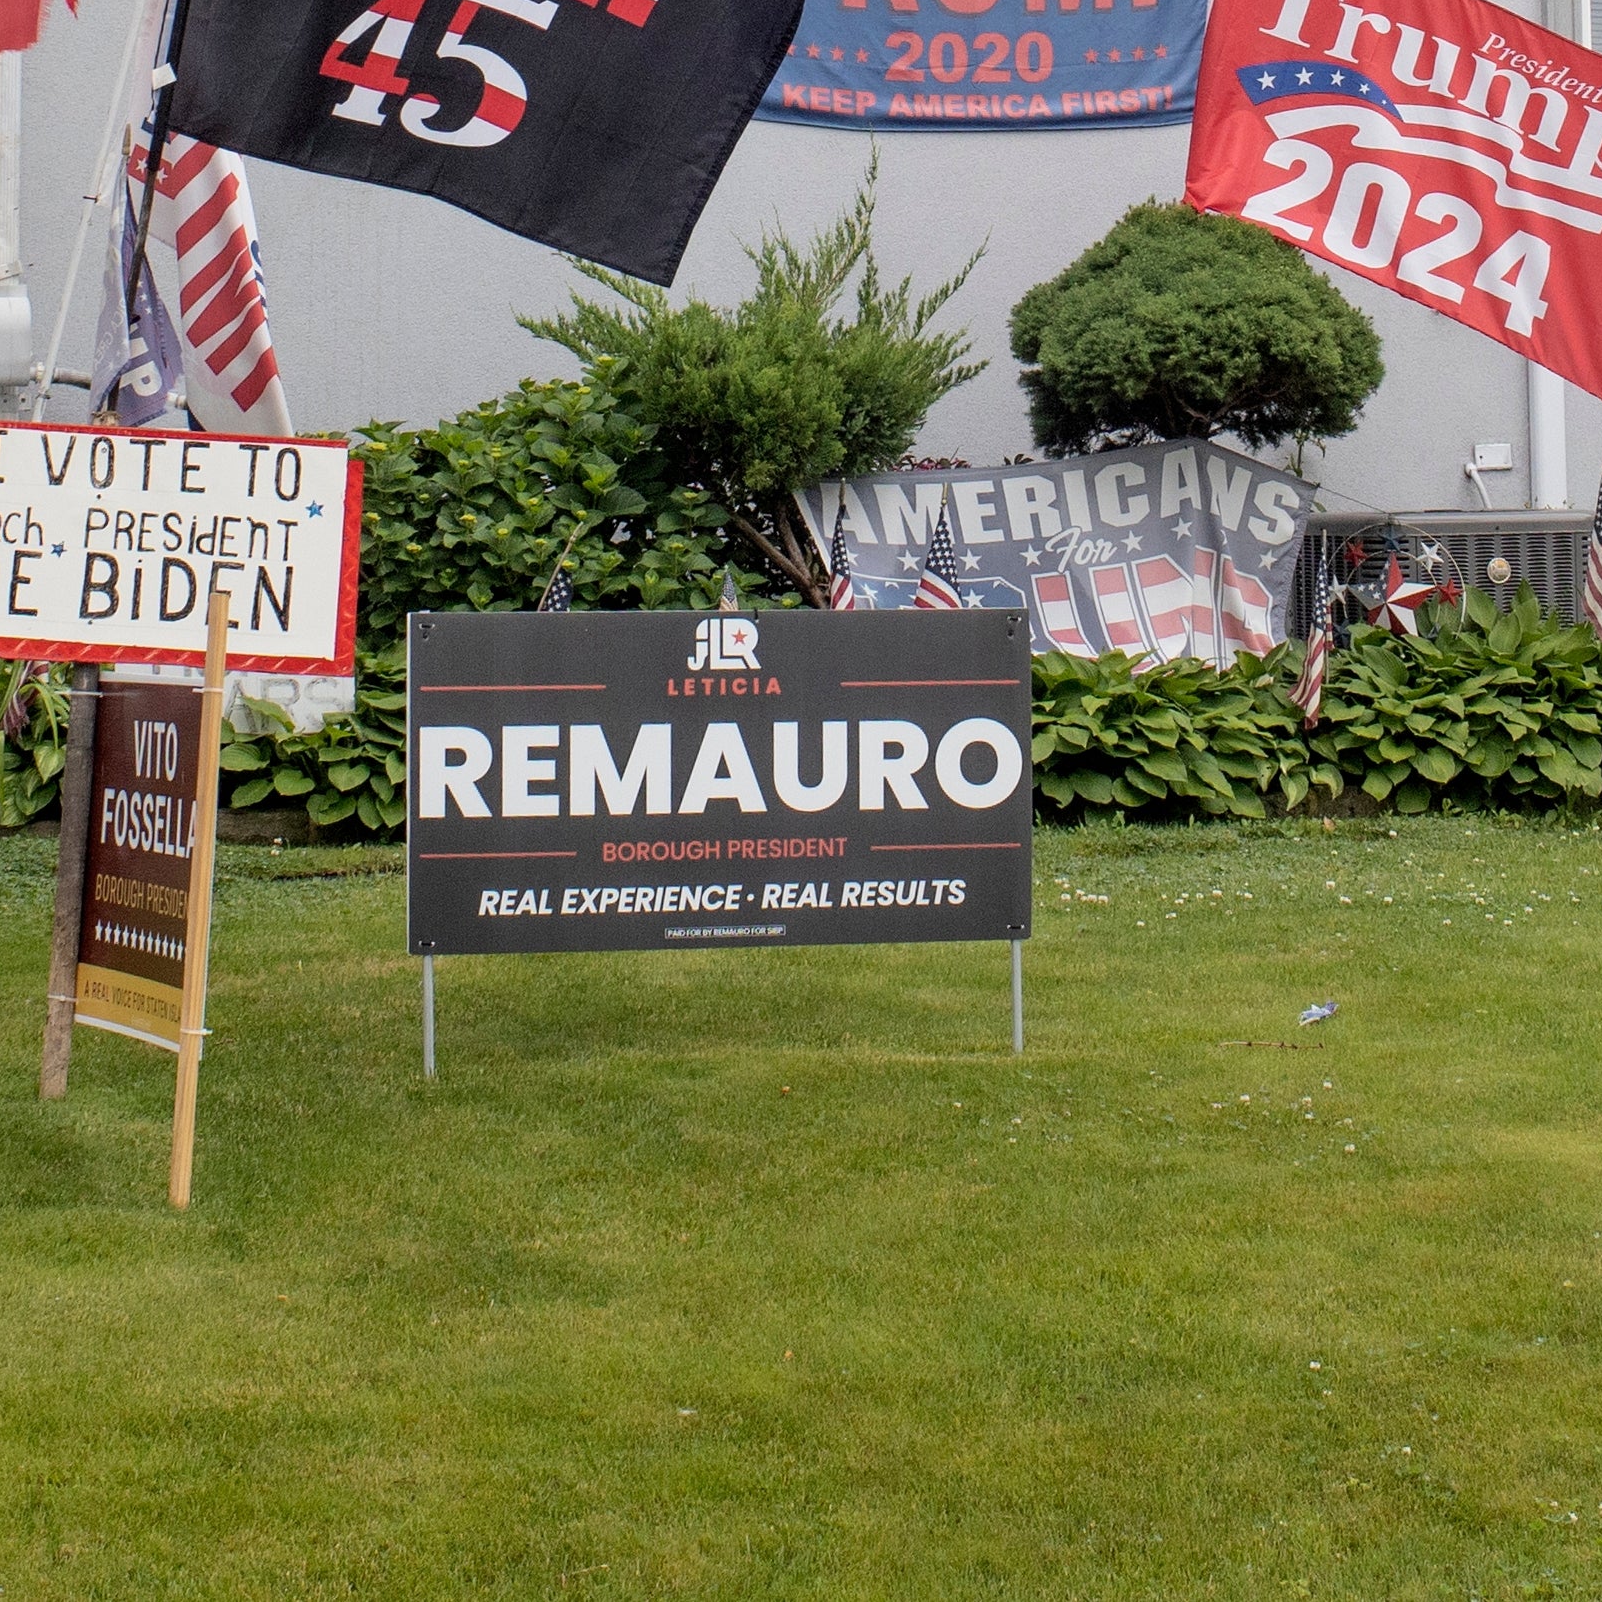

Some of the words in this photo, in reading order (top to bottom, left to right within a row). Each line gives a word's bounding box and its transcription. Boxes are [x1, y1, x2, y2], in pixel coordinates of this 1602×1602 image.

[884, 32, 1055, 85] 2020
[781, 84, 878, 117] KEEP
[887, 94, 1054, 120] AMERICA
[1061, 84, 1174, 116] FIRST!
[1240, 137, 1552, 339] 2024
[40, 432, 212, 494] VOTE
[238, 443, 302, 502] TO
[818, 444, 1300, 547] AMERICANS
[1044, 526, 1118, 574] For
[667, 677, 781, 697] LETICIA
[133, 719, 179, 783] VITO
[419, 717, 1023, 819] REMAURO
[602, 839, 722, 863] BOROUGH
[727, 837, 848, 860] PRESIDENT
[94, 872, 145, 910] BOROUGH
[478, 889, 553, 916] REAL
[560, 884, 743, 914] EXPERIENCE
[761, 882, 833, 909] REAL
[840, 879, 967, 907] RESULTS
[84, 979, 90, 998] A
[92, 982, 109, 1002] REAL
